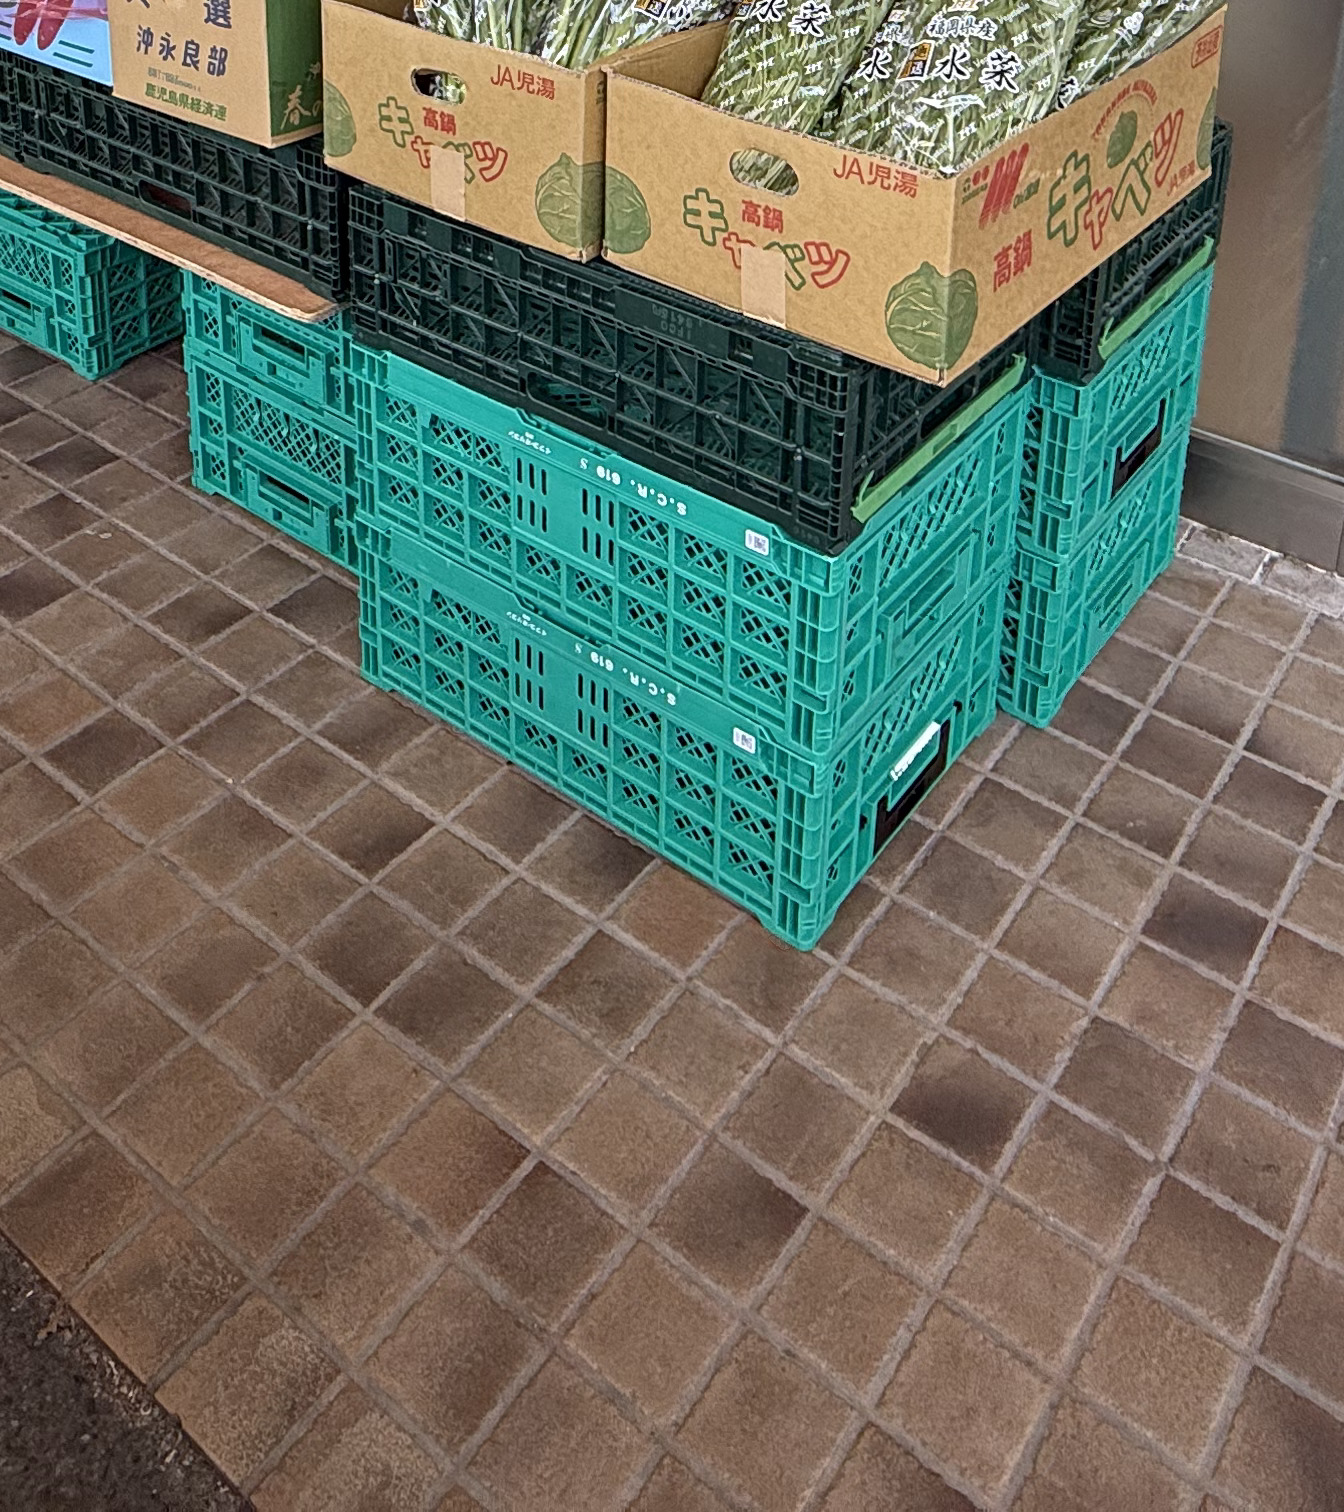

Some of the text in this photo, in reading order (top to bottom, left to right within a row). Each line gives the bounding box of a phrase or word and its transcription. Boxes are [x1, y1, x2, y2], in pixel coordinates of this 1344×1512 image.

[927, 16, 996, 41] 福岡県産
[135, 24, 229, 78] 沖永良部
[935, 45, 1021, 94] 水菜
[145, 82, 228, 122] 鹿児島県経済連
[490, 63, 556, 101] JA児湯
[421, 106, 458, 137] 高鍋
[832, 154, 920, 200] JA児湯
[1045, 107, 1185, 252] キャベツ
[740, 199, 785, 234] 高鍋
[992, 228, 1033, 293] 高鍋
[629, 477, 688, 517] S.C.R.
[622, 667, 678, 707] S.C.R.
